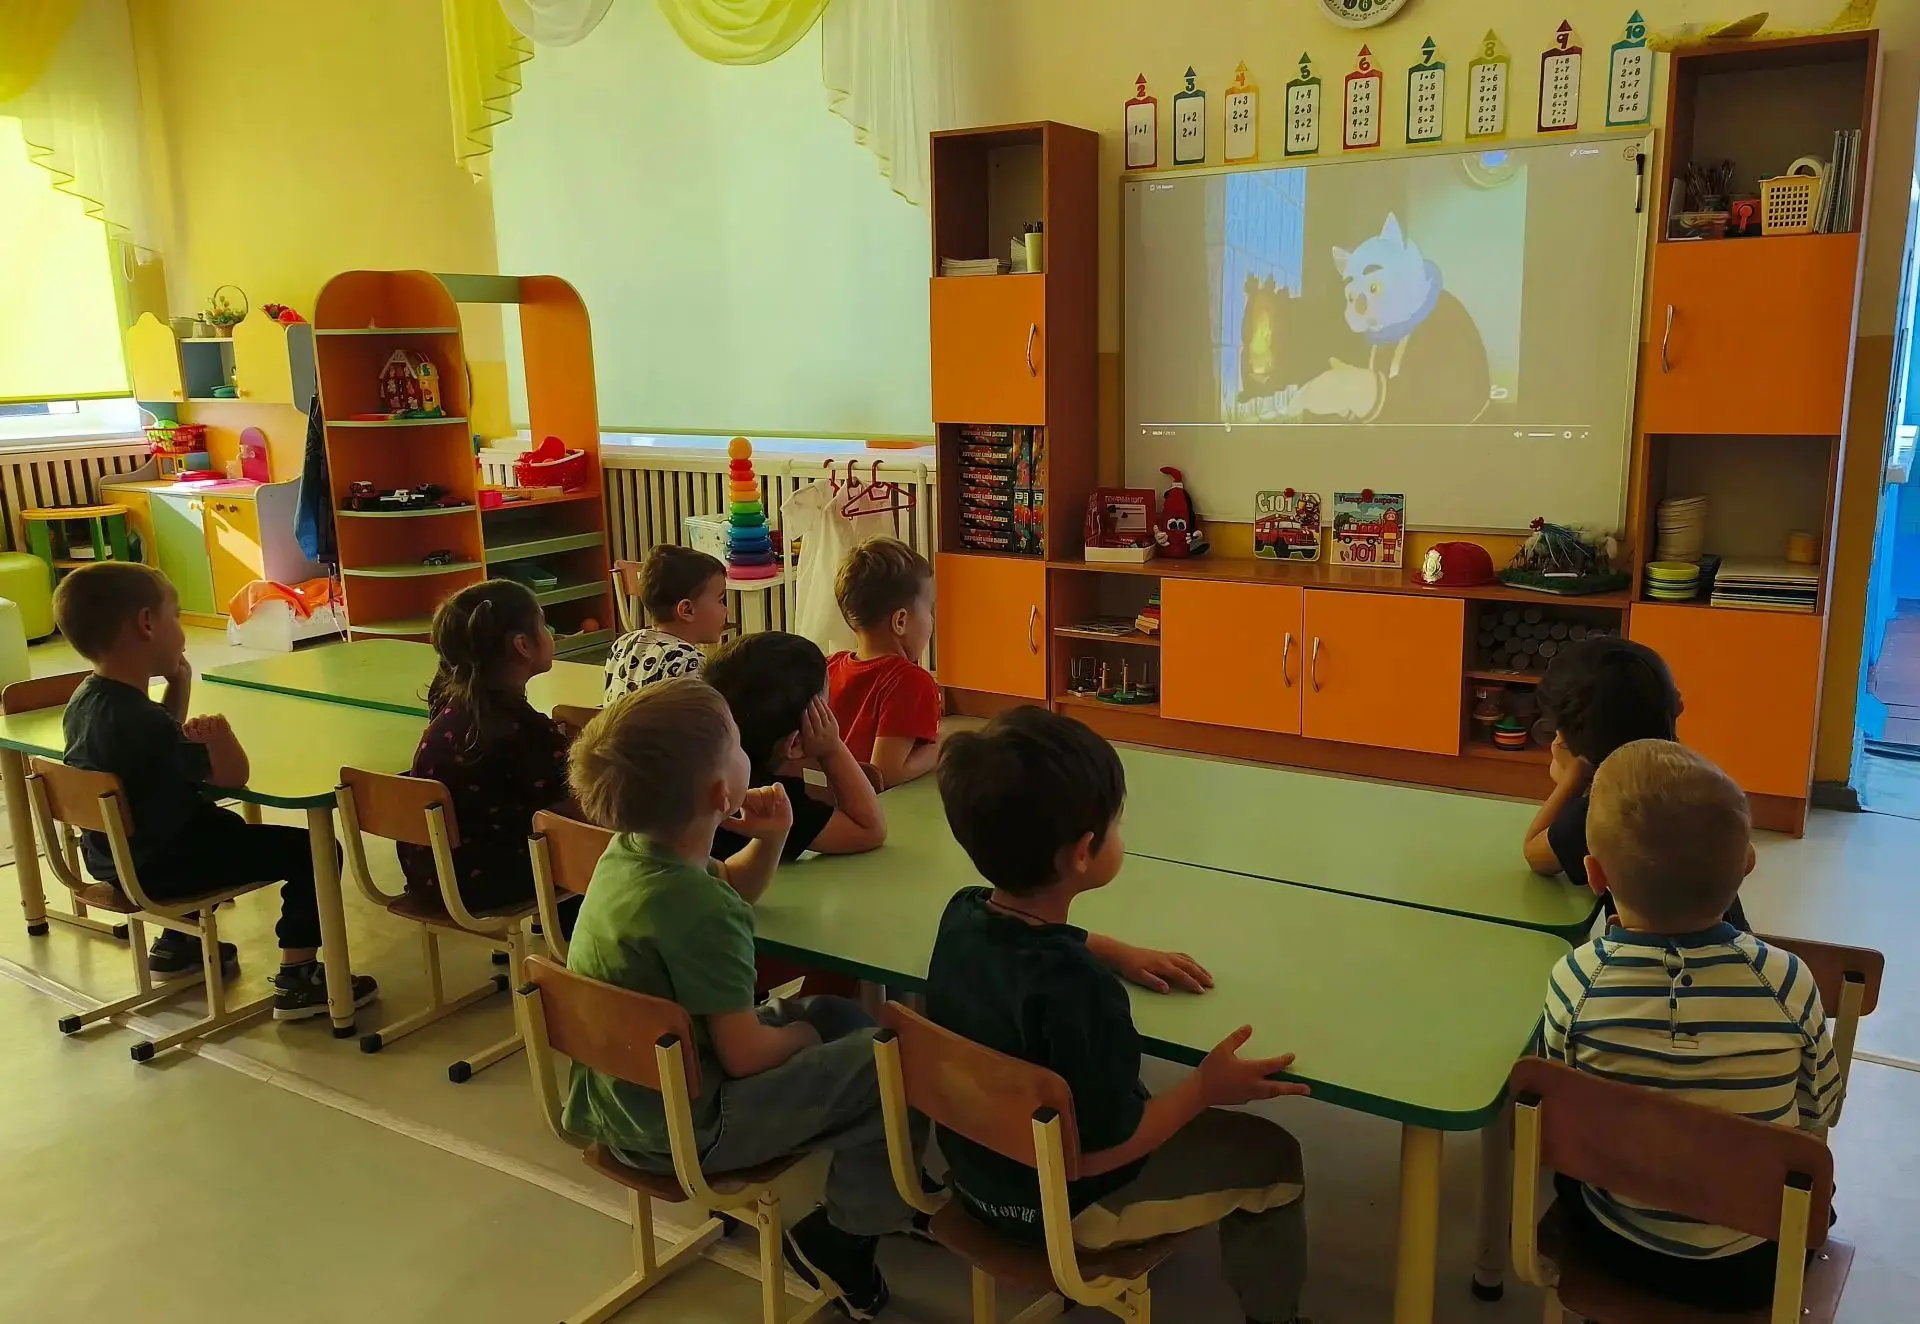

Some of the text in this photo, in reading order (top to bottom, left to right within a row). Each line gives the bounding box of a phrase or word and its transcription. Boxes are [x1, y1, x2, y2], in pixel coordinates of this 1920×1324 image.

[1624, 24, 1646, 40] 10
[1556, 32, 1569, 49] 9
[1422, 49, 1435, 64] 7
[1484, 42, 1495, 57] 8
[1300, 64, 1311, 79] 5
[1359, 57, 1370, 72] 6
[1185, 78, 1195, 92] 3
[1235, 72, 1246, 87] 4
[1136, 84, 1146, 97] 2
[1268, 495, 1293, 513] 101
[1350, 543, 1377, 563] 101
